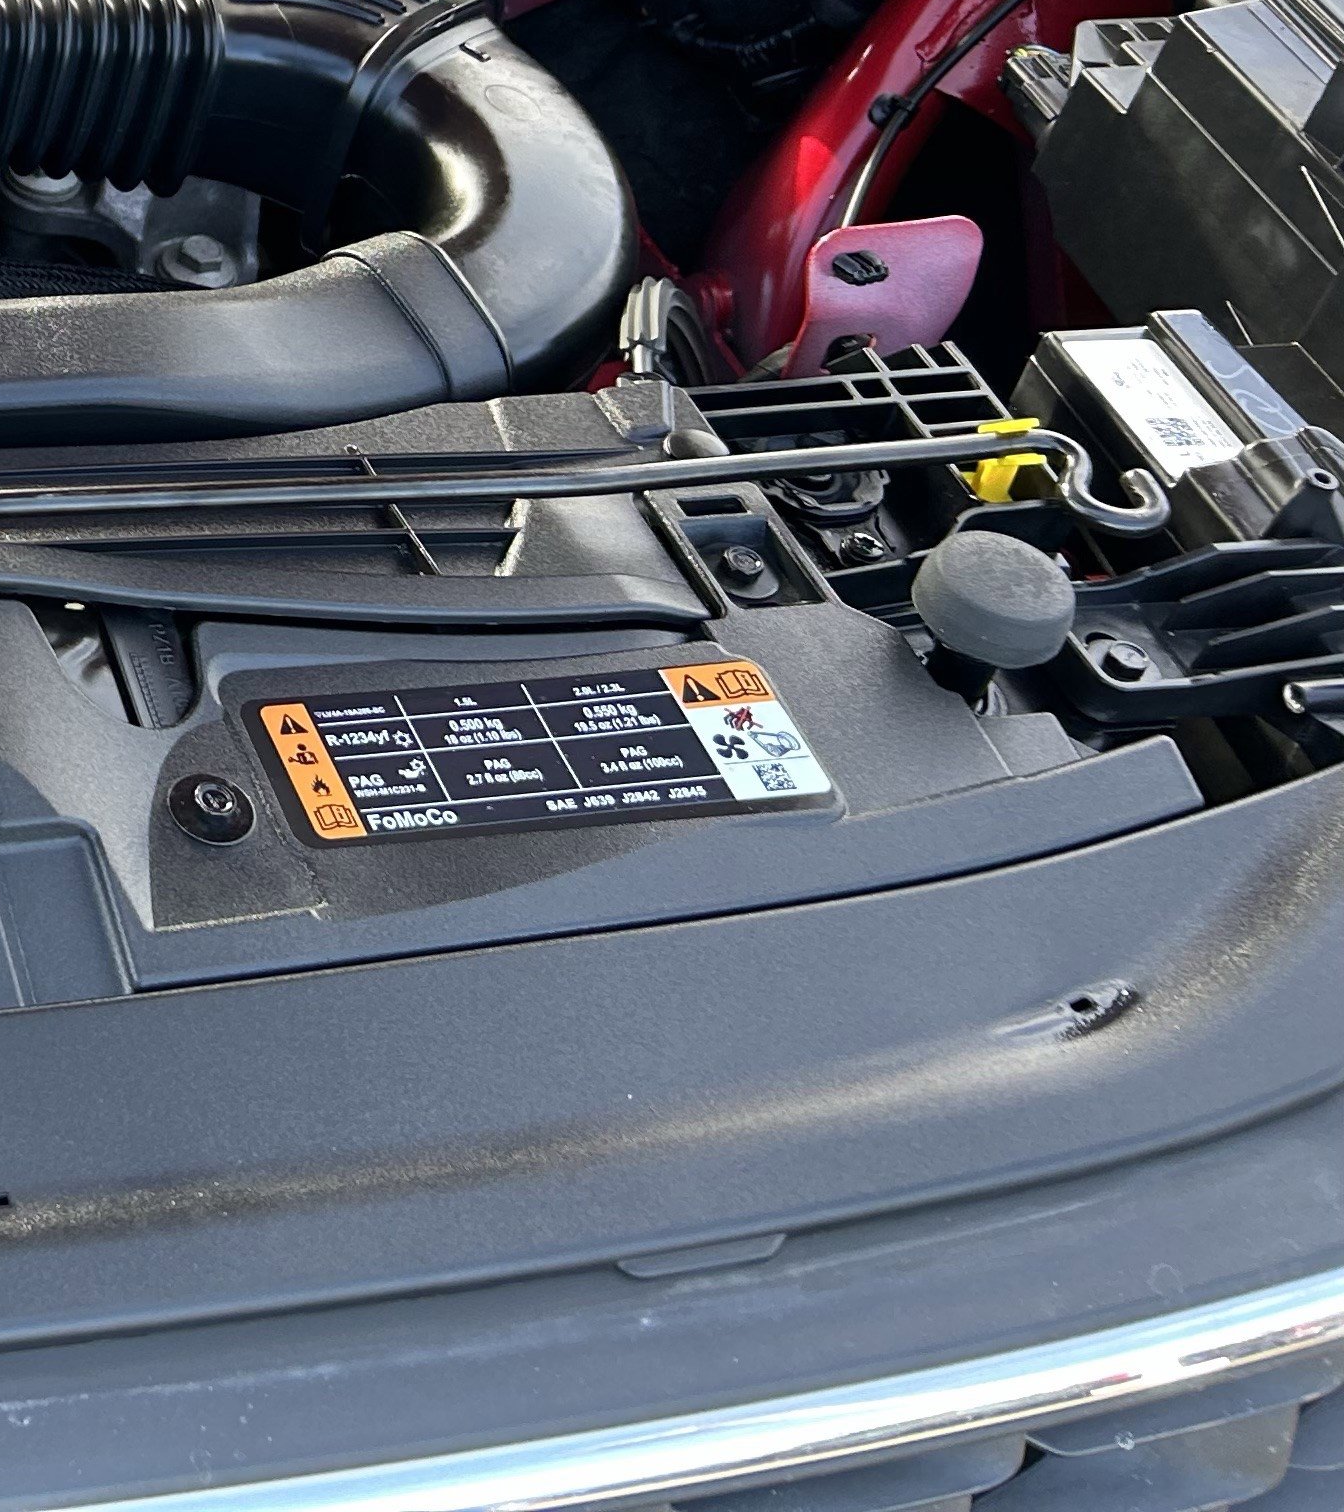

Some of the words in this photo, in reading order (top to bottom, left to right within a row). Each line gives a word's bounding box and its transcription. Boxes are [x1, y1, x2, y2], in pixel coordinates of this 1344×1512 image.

[582, 704, 618, 719] 0.550
[617, 702, 638, 716] kg
[448, 718, 484, 732] 0.500
[483, 717, 504, 730] kg
[597, 720, 613, 730] oz
[324, 729, 391, 747] R-1234yf
[459, 734, 474, 744] oz
[619, 745, 648, 758] PAG
[483, 758, 512, 770] PAG
[600, 760, 619, 774] 3.4
[628, 760, 644, 771] oz
[347, 773, 385, 789] PAG
[466, 773, 483, 786] 2.7
[494, 773, 510, 782] oz
[545, 797, 579, 811] SAE
[583, 794, 616, 808] J639
[366, 808, 458, 831] FoMoCo
